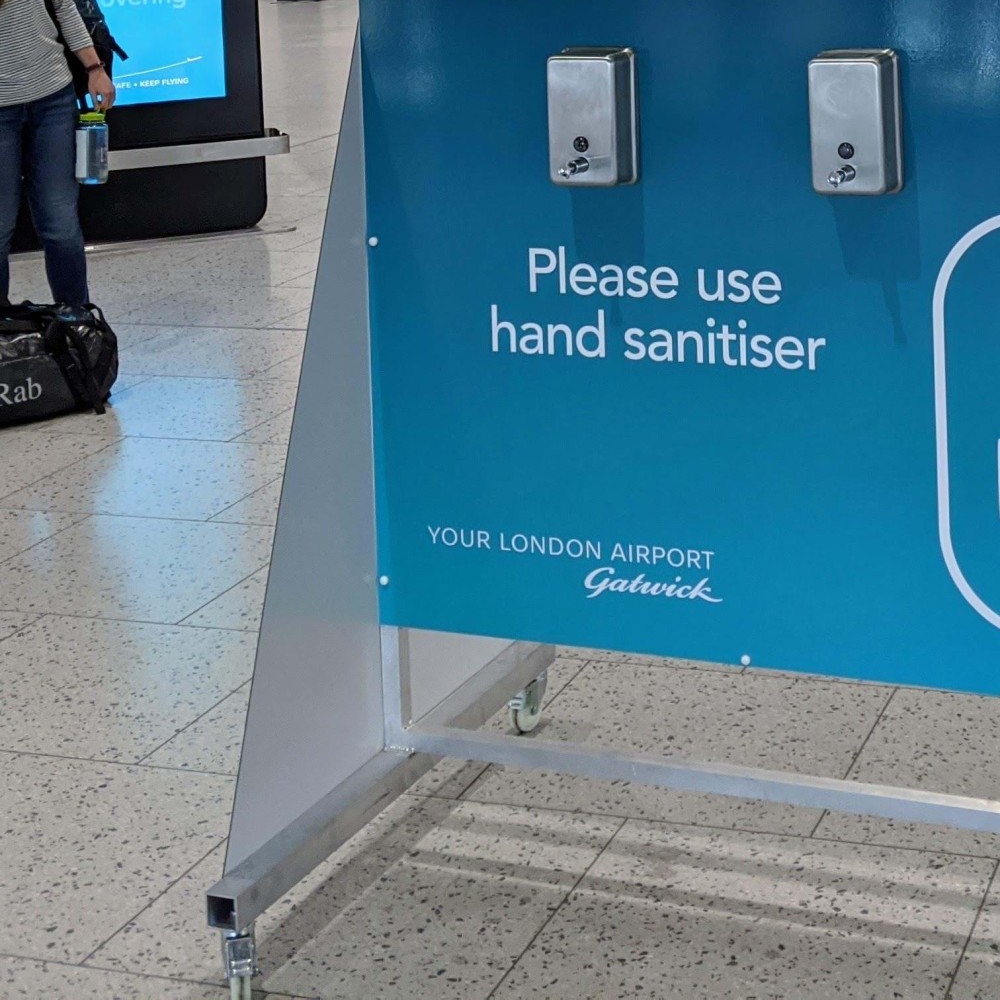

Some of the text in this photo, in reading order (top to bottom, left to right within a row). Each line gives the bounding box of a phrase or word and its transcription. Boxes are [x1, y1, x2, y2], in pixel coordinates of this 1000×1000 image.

[114, 77, 189, 89] AFE KEEP FLYING
[528, 245, 782, 304] Please use
[490, 304, 826, 370] hand sanitiser
[0, 377, 42, 407] Rab
[427, 525, 714, 571] YOUR LONDON AIRPORT
[584, 567, 724, 603] Gatwick
